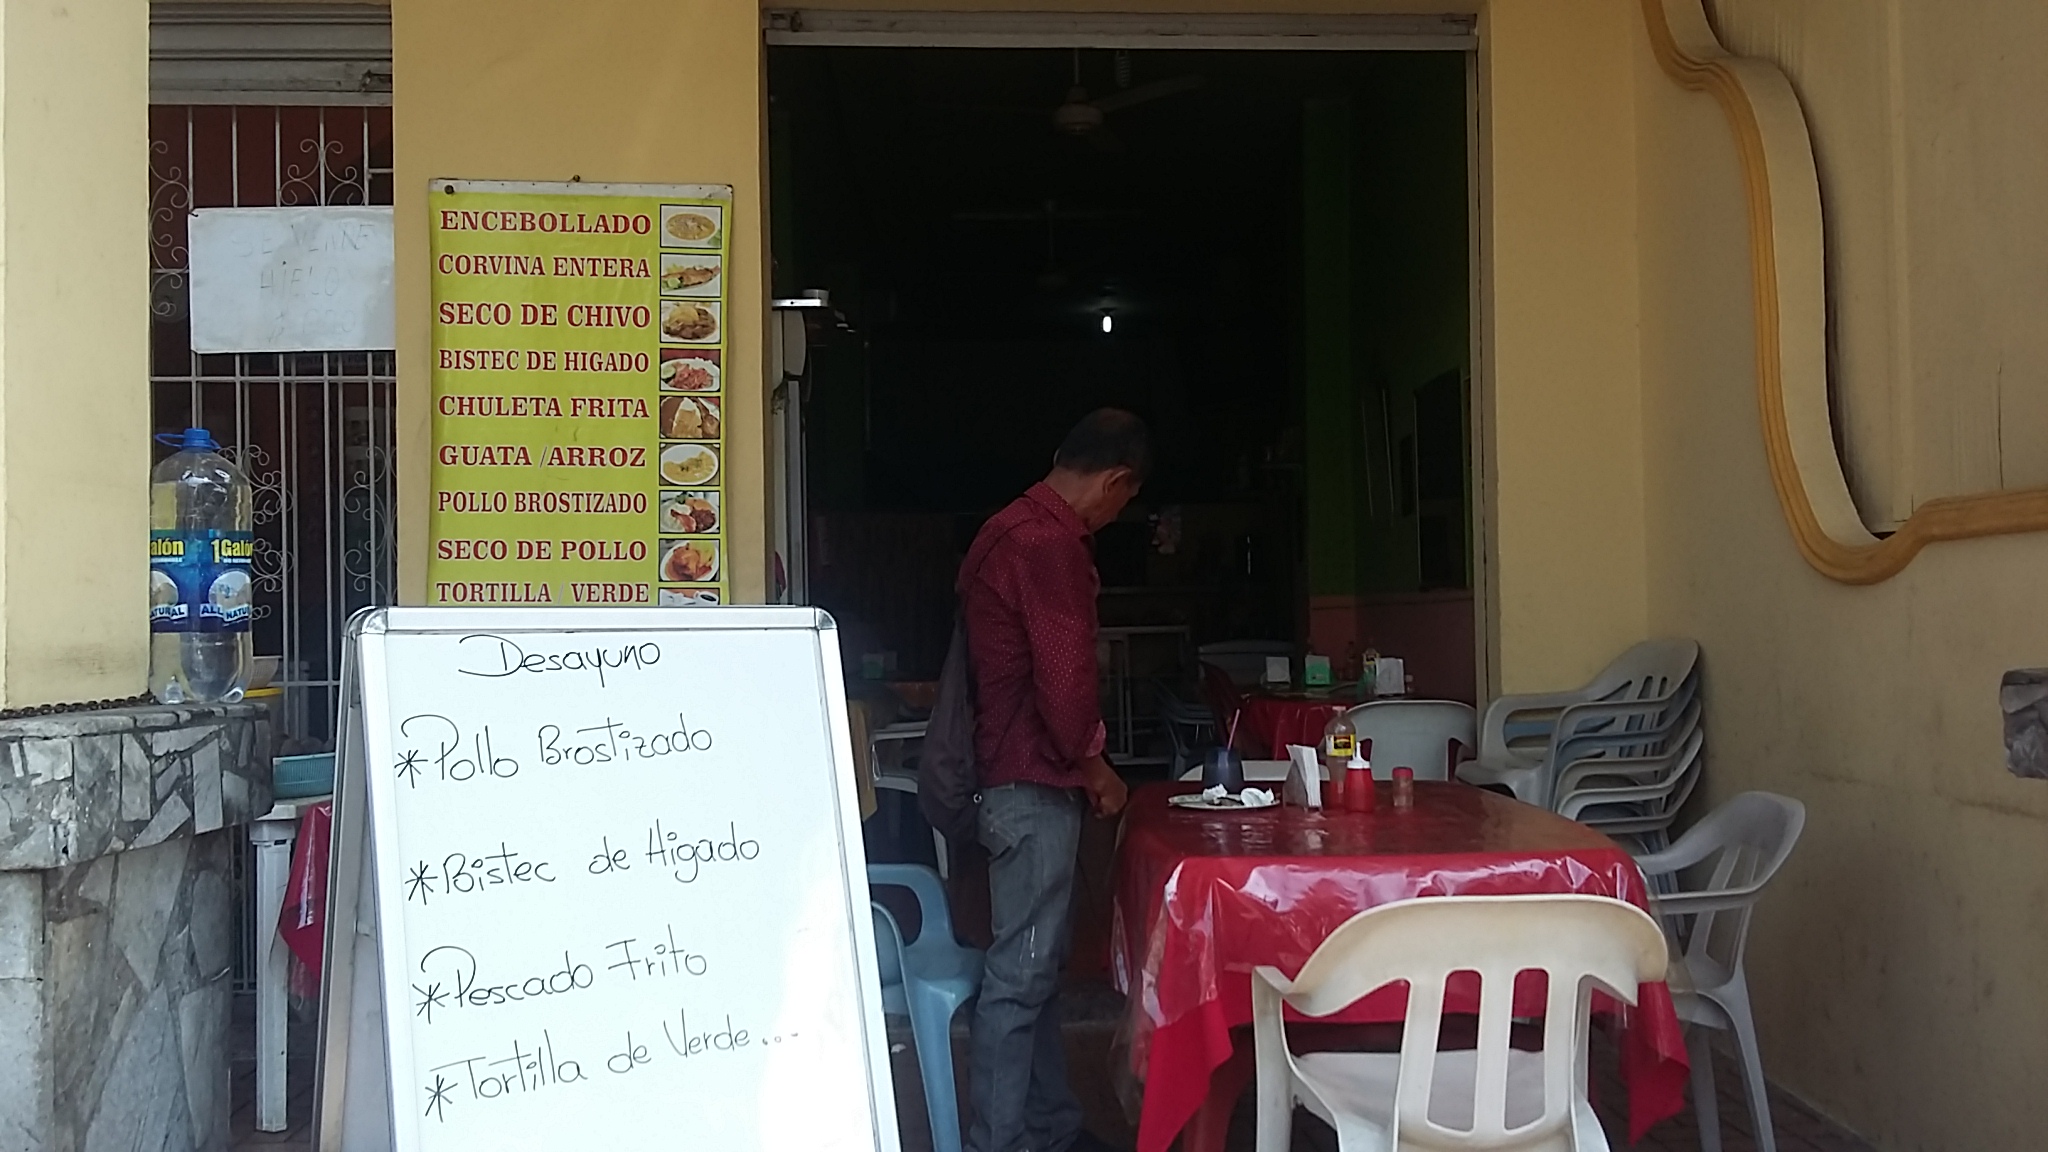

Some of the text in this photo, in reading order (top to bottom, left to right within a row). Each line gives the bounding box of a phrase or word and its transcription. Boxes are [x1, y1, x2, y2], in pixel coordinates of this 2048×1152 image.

[440, 210, 651, 235] ENCEBOLLADO
[438, 254, 652, 278] CORVINA ENTERA
[439, 303, 651, 328] SECO DE CHIVO
[439, 349, 650, 373] BISTEC DE HIGADO
[438, 395, 650, 418] CHULETA FRITA
[439, 445, 532, 466] GUATA
[438, 491, 647, 514] POLLO BROSTIZADO
[151, 538, 185, 557] alón
[438, 540, 647, 560] SECO DE POLLO
[436, 583, 552, 603] TORTILLA
[571, 583, 649, 603] VERDE
[201, 606, 224, 616] ALL
[457, 634, 662, 687] Desayuno
[401, 713, 713, 781] Pollo Brostizado
[443, 819, 760, 893] Bistec de Higado
[420, 924, 708, 1007] Pescado Frito
[429, 1029, 588, 1100] Tortilla
[606, 1030, 652, 1074] de
